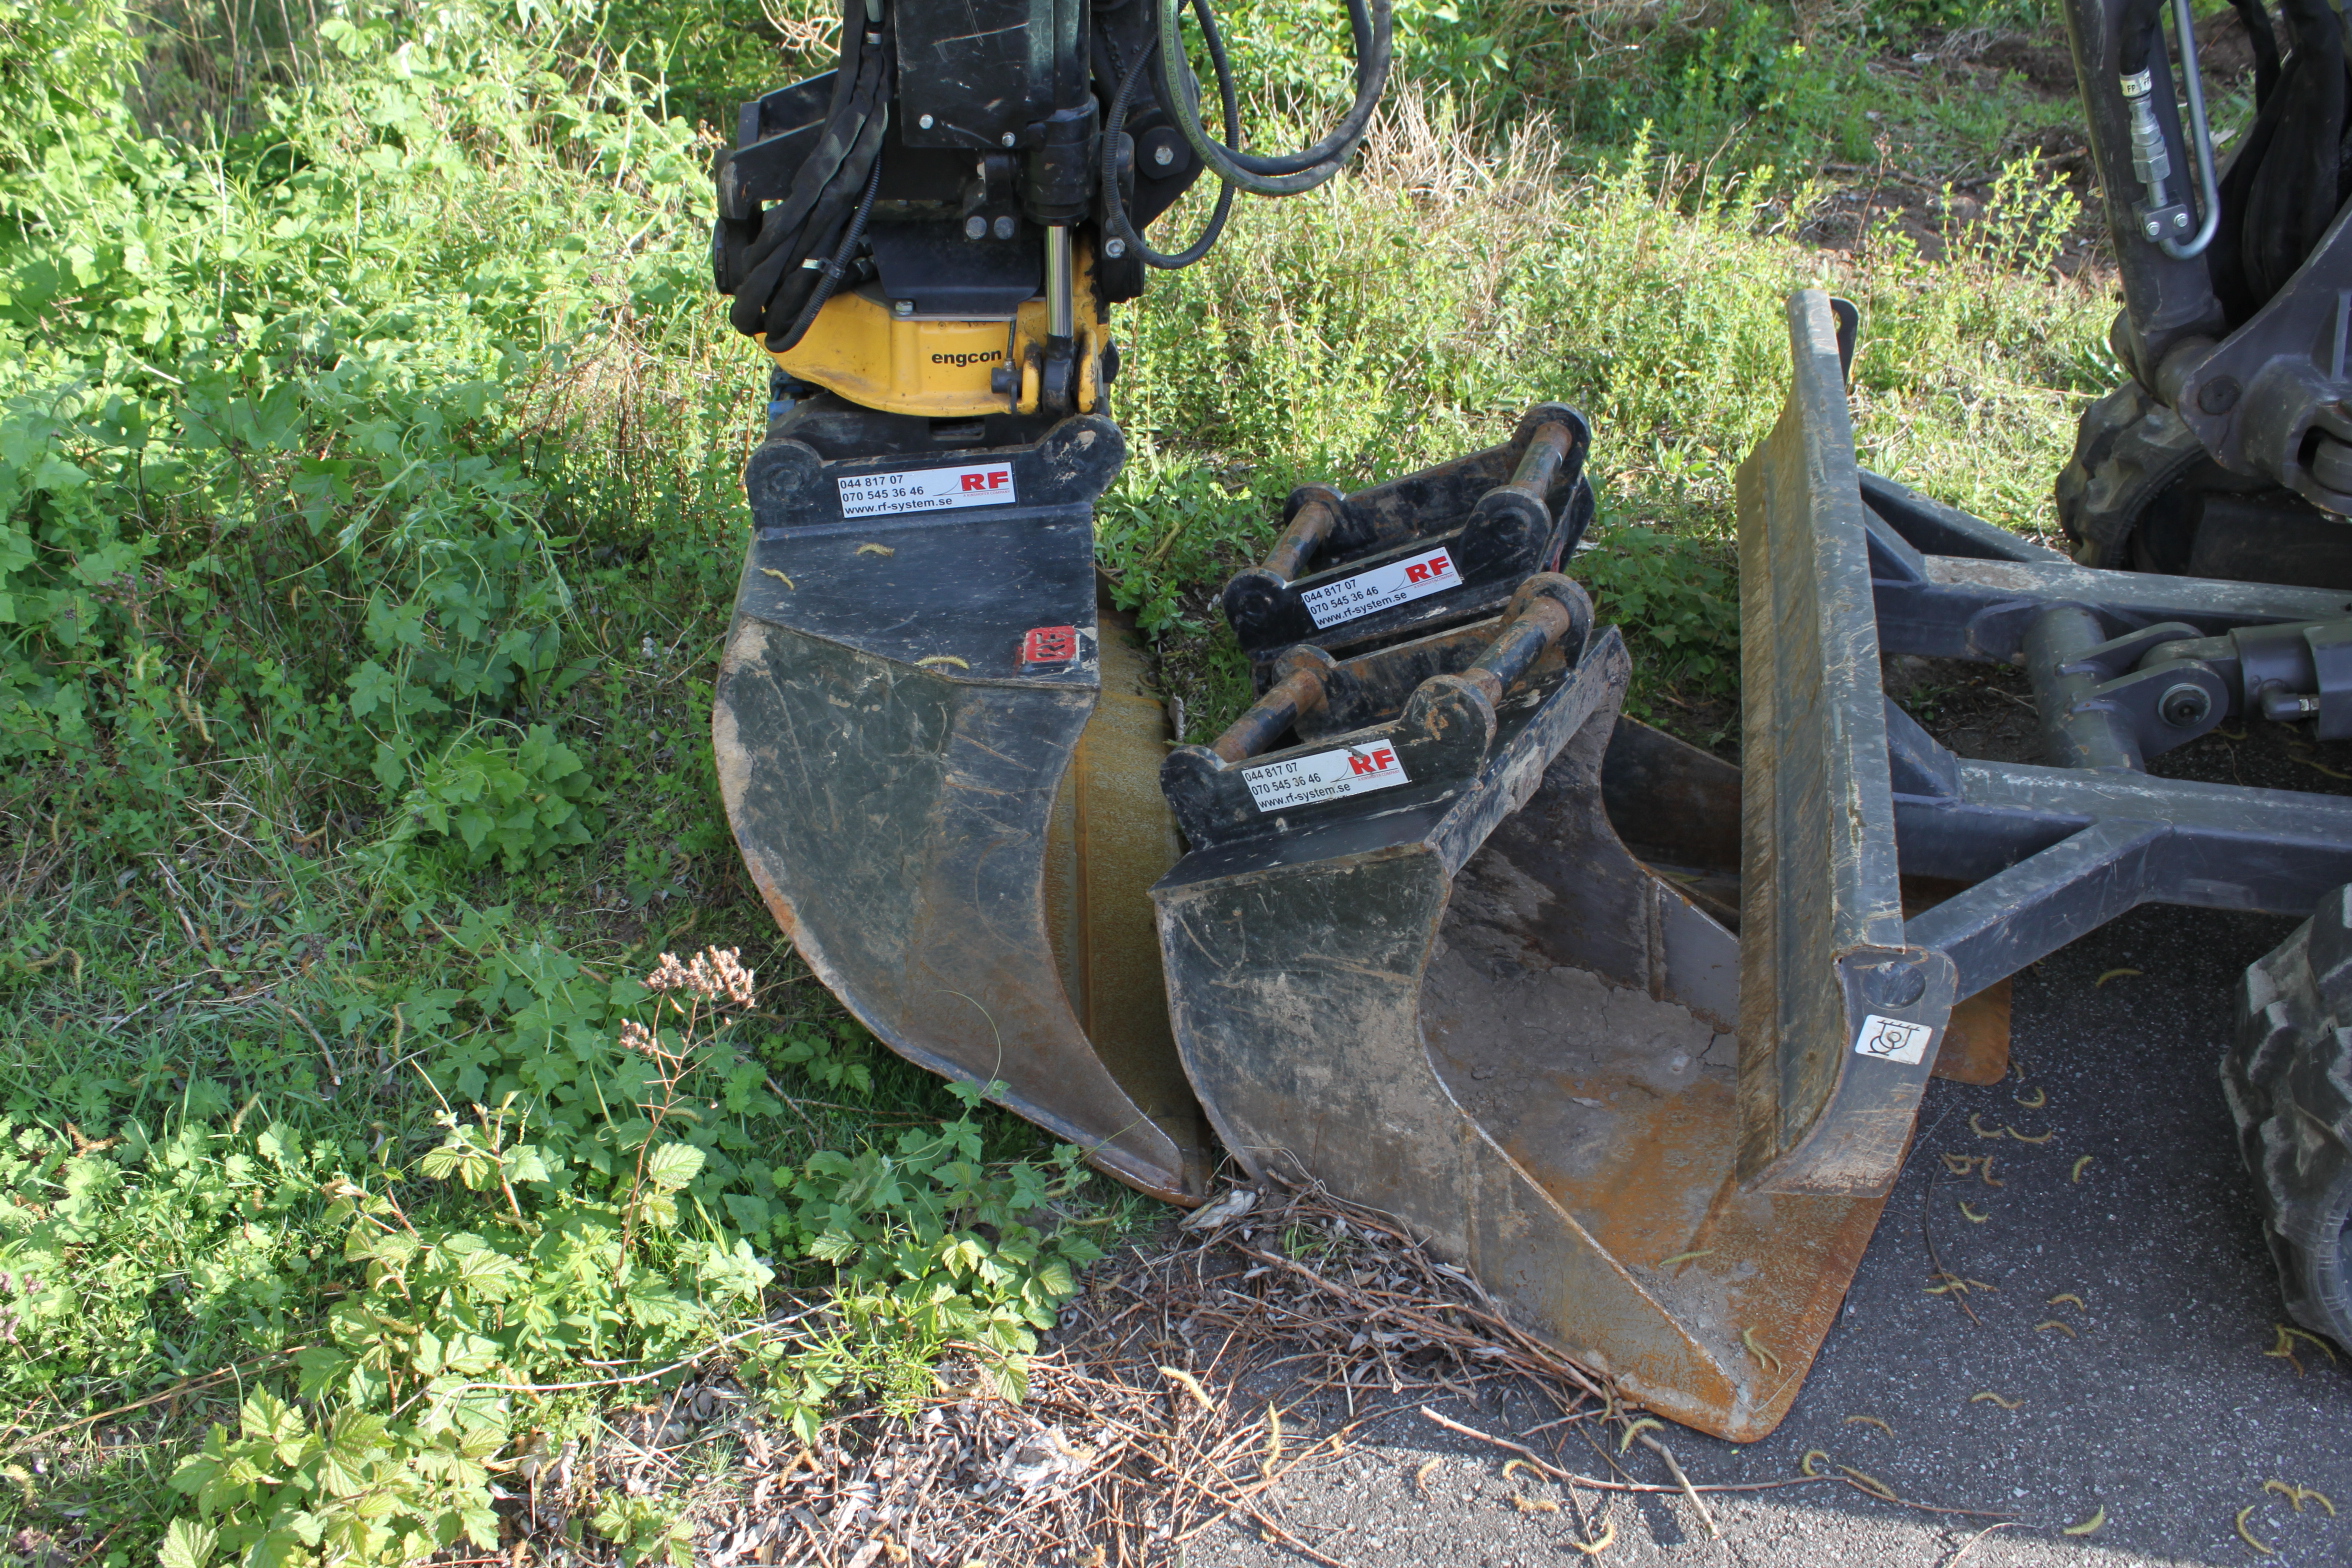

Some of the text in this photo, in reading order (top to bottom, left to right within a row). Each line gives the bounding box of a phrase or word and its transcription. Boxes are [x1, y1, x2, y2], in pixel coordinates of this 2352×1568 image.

[1165, 48, 1174, 60] EN
[1168, 65, 1185, 110] EXCEEDS
[1182, 112, 1198, 141] MSHA
[931, 350, 1002, 368] engcon
[840, 475, 904, 489] 044 817 07
[960, 471, 1009, 492] RF
[842, 486, 924, 502] 070 545 36 46
[845, 498, 952, 515] www.rf-system.se
[1405, 556, 1450, 583] RF
[1304, 579, 1357, 603] 044 817 07
[1310, 586, 1379, 615] 070 545 36 46
[1316, 592, 1408, 626] www.rf-system.se
[1245, 762, 1298, 782] 044 817 07
[1348, 749, 1395, 775] RF
[1251, 773, 1322, 796] 070 545 36 46
[1258, 783, 1351, 808] www.rf-system.se
